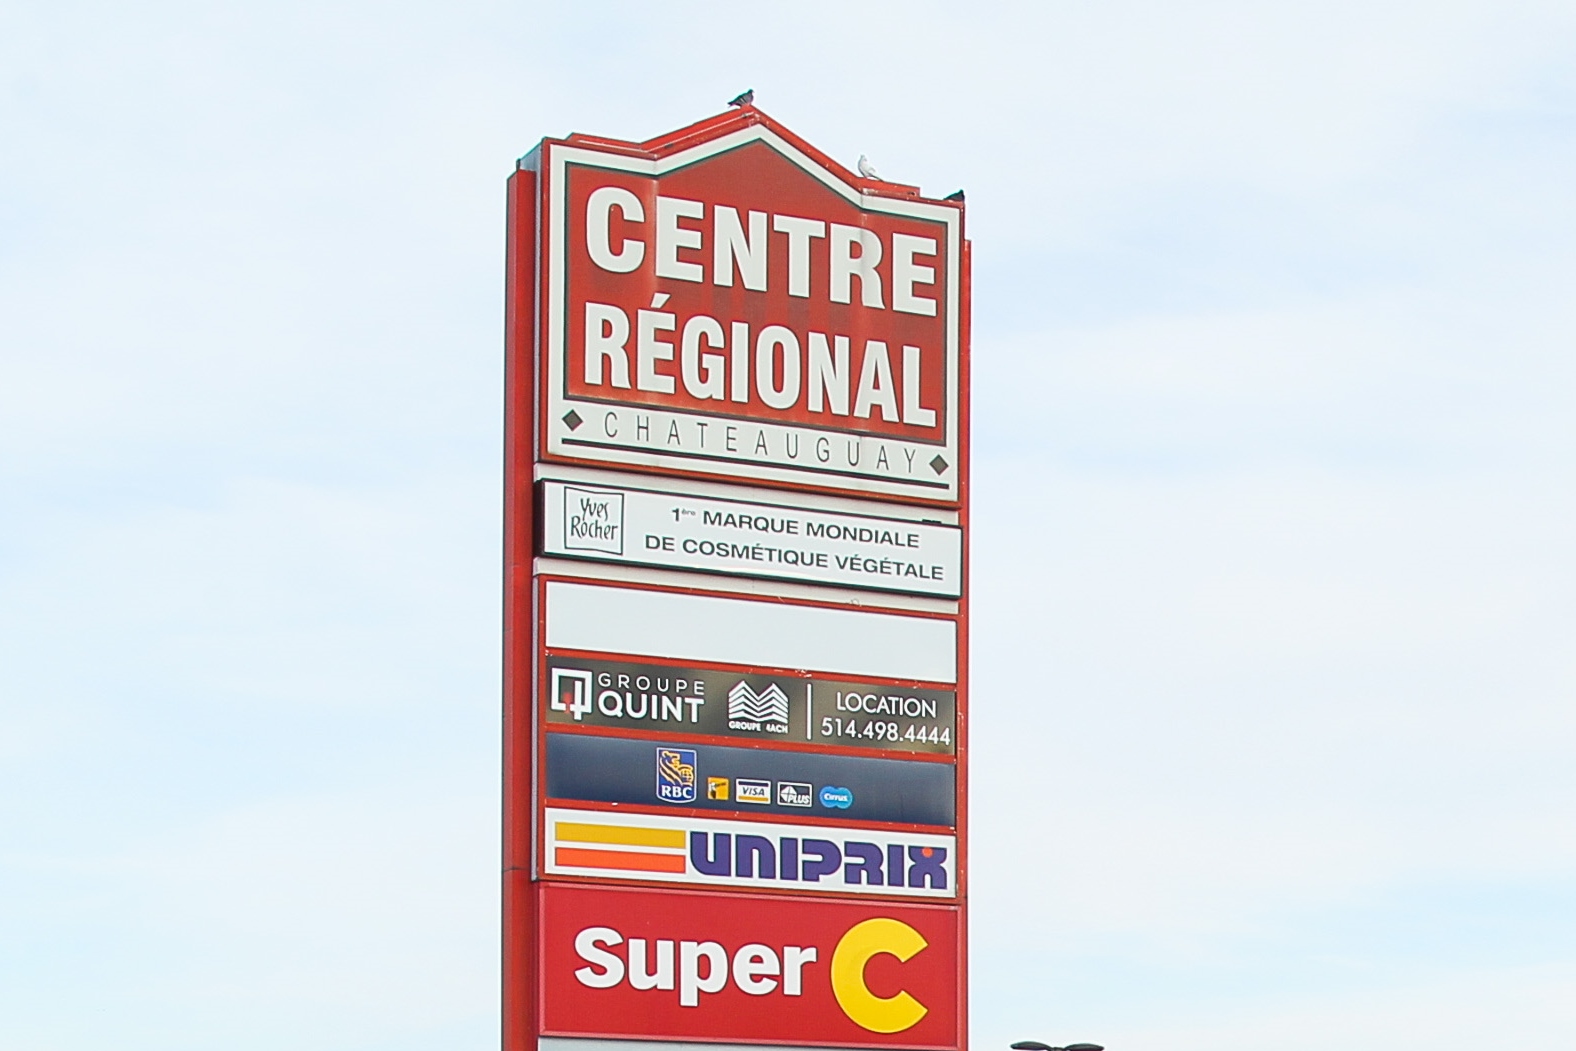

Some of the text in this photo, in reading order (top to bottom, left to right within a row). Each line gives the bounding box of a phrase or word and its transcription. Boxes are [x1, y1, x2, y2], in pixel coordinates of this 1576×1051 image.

[586, 186, 937, 316] CENTRE
[584, 293, 936, 427] RÉGIONAL
[604, 411, 917, 473] CHATEAUGUAY
[580, 497, 609, 521] Yves
[570, 515, 618, 540] Rocher
[702, 510, 799, 535] MARQUE
[806, 522, 920, 548] MONDIALE
[645, 534, 944, 580] DE COSMÉTIQUE VÉGÉTALE
[597, 672, 705, 696] GROUPE
[597, 690, 705, 723] QUINT
[836, 691, 937, 719] LOCATION
[728, 720, 761, 732] GROUPE
[820, 716, 951, 746] 514.498.4444
[661, 785, 692, 799] RBC
[742, 786, 765, 796] VISA
[788, 793, 810, 805] PLUS
[689, 830, 948, 890] UNIPRIX
[573, 917, 929, 1034] Super C
